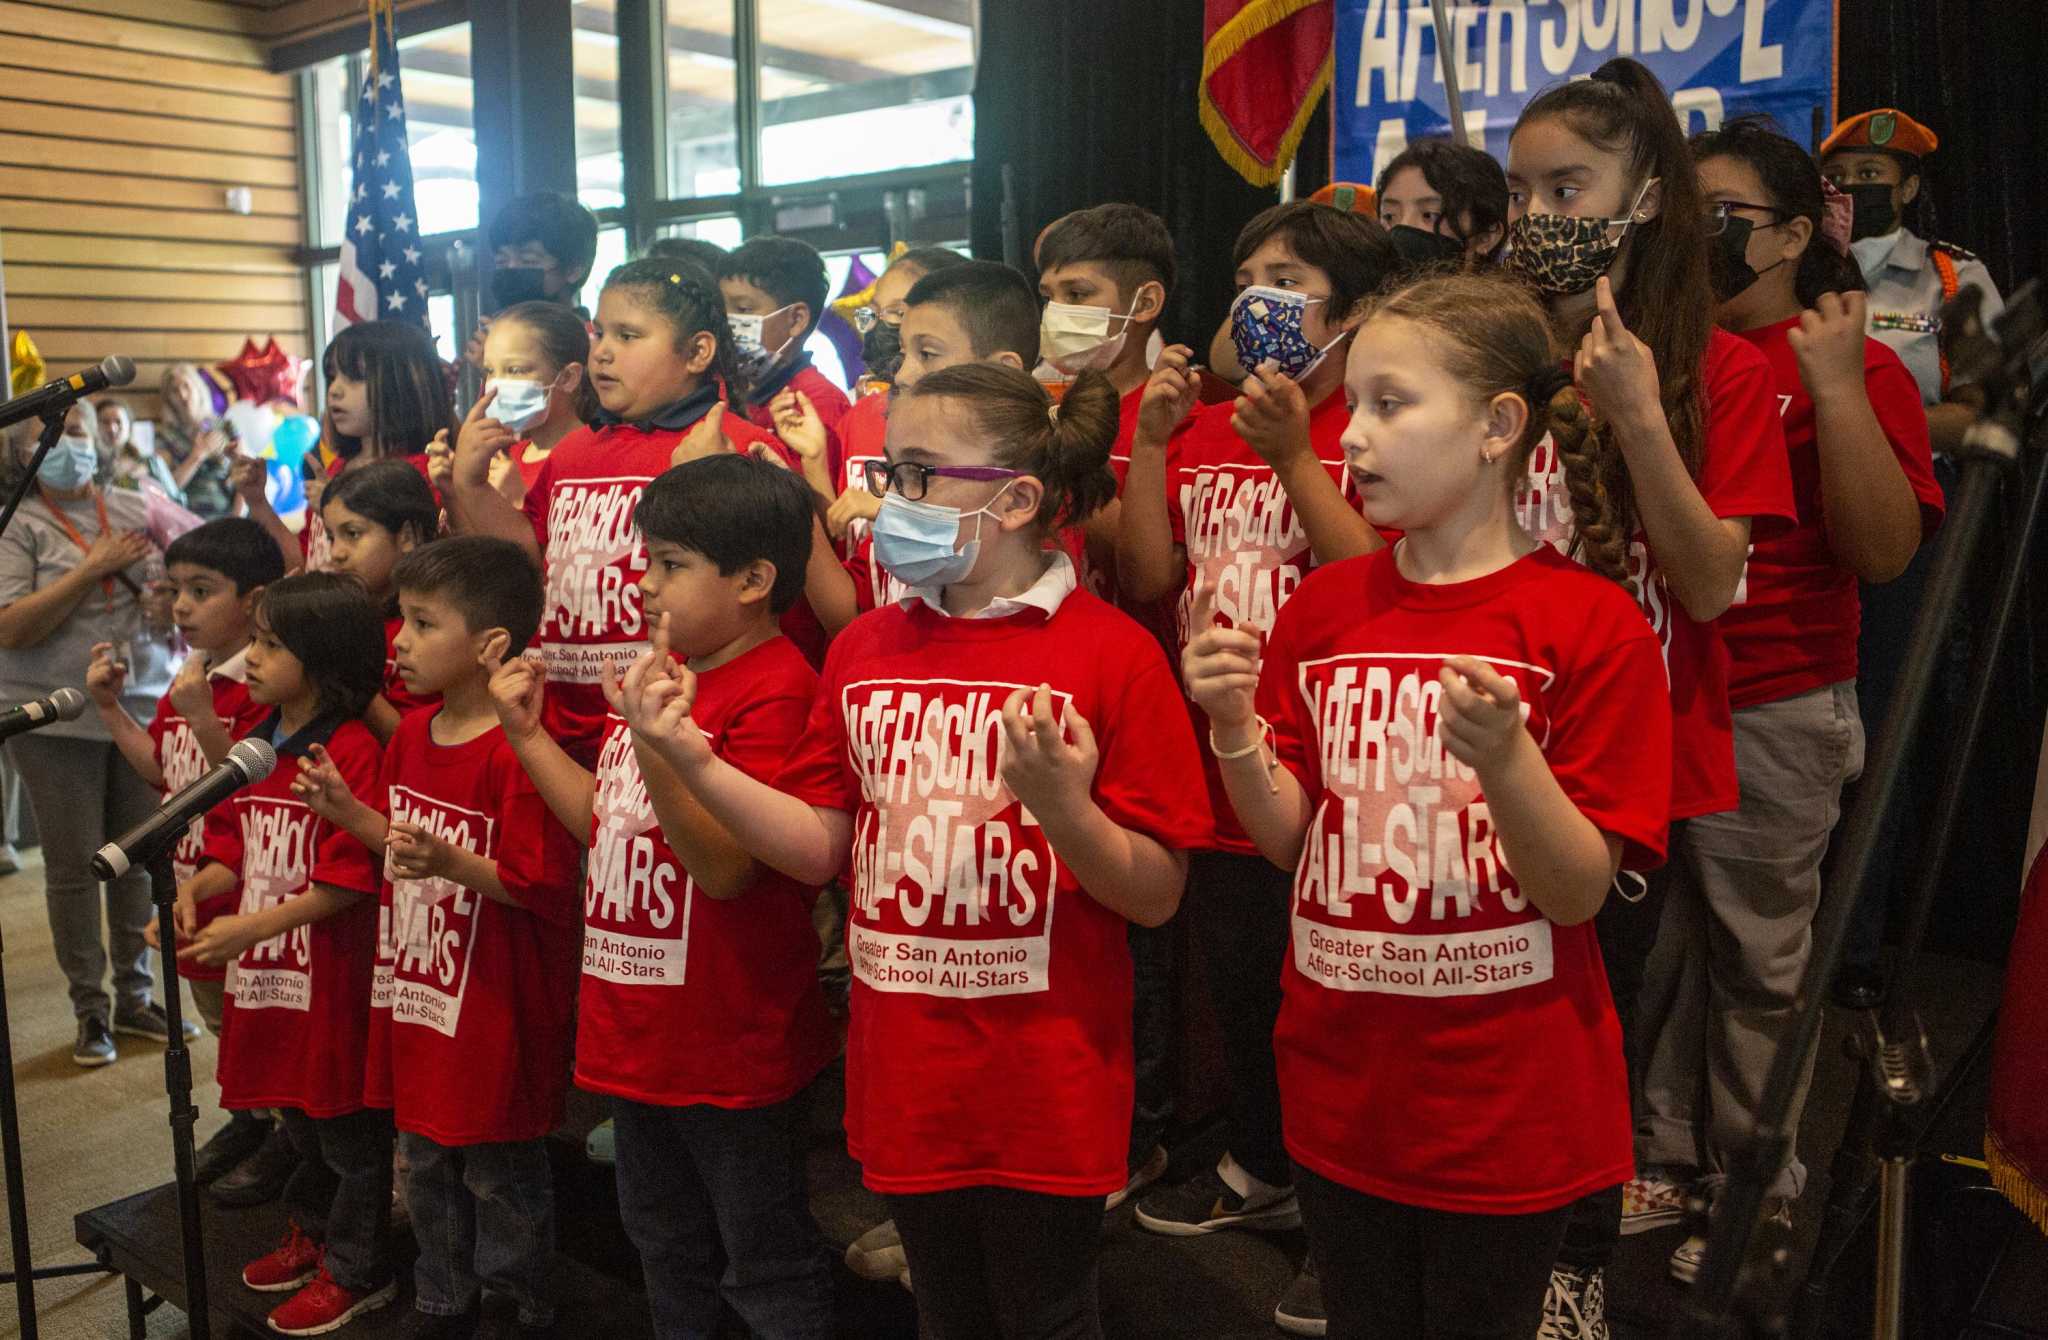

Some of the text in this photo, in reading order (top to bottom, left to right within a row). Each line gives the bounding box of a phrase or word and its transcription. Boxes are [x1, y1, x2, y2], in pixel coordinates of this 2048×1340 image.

[584, 935, 598, 950] an
[600, 937, 665, 960] Antonio
[857, 934, 1027, 966] Greater San Antonio
[1309, 929, 1530, 963] Greater San Antonio
[598, 955, 665, 978] All-Stars
[1306, 952, 1534, 987] After-School All-Stars
[251, 975, 304, 989] Antonio
[940, 970, 1030, 988] All-Stars
[248, 988, 303, 1003] All-Stars
[399, 986, 446, 1011] Antonio
[395, 1002, 446, 1026] All-Stars
